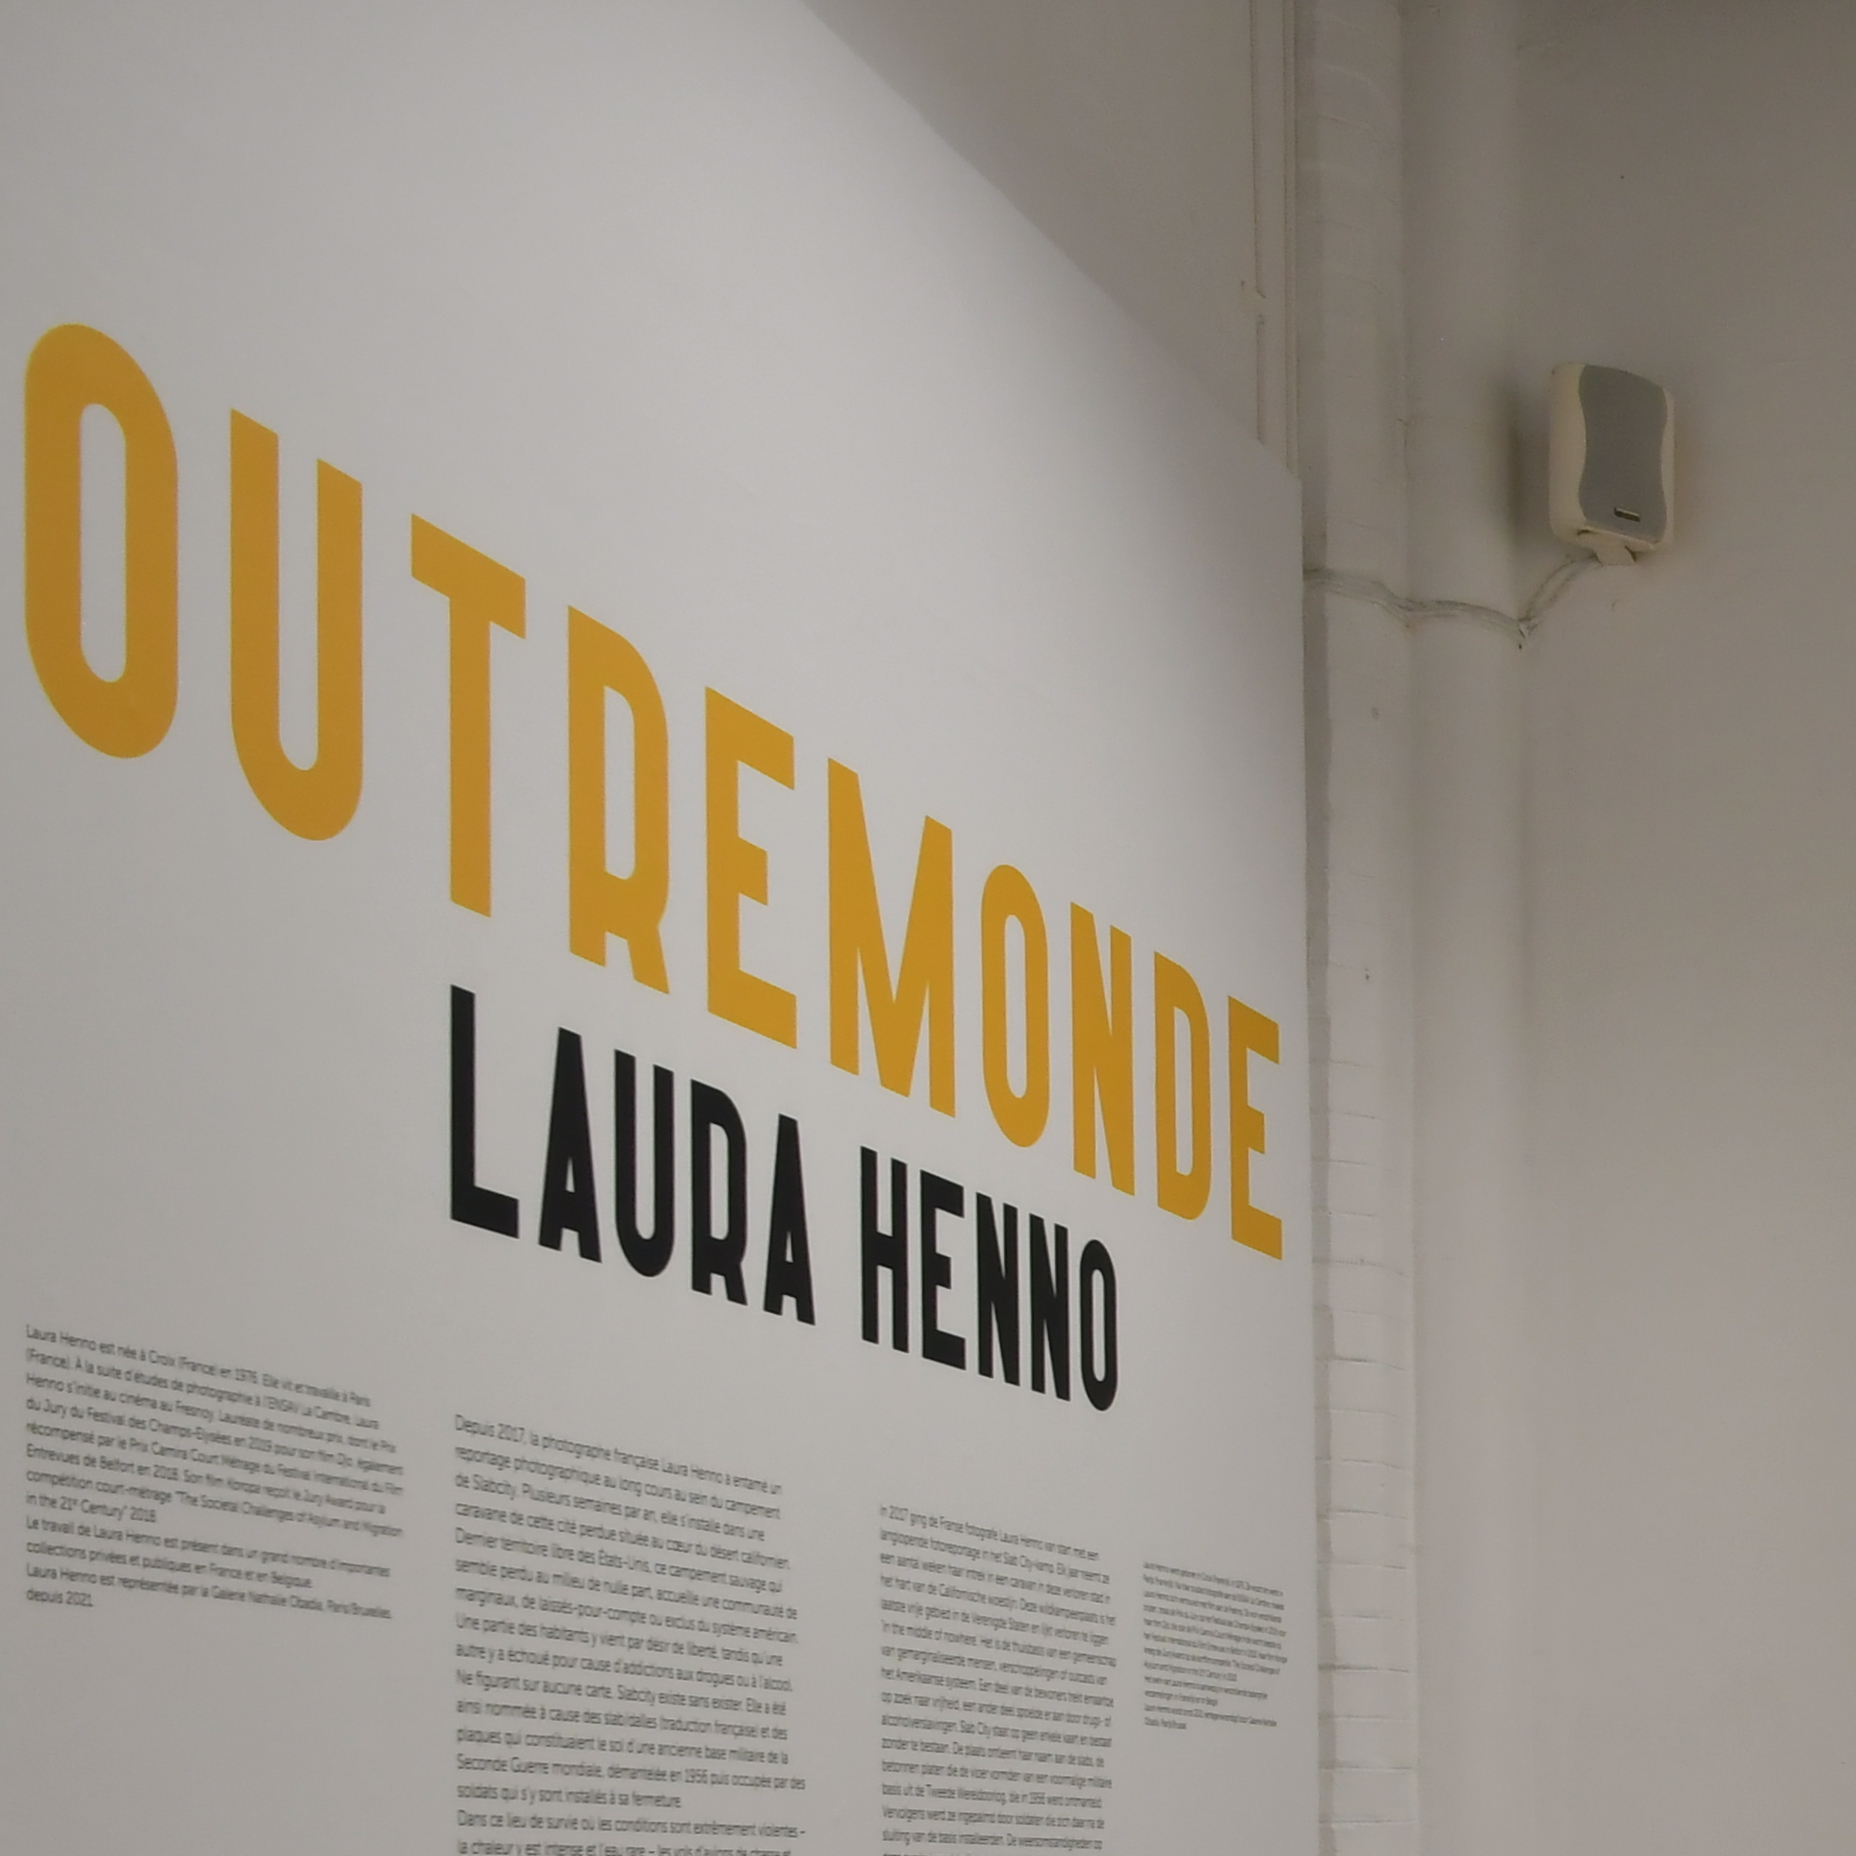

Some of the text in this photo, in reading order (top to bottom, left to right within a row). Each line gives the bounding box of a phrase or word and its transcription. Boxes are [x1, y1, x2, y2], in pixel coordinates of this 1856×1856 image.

[24, 324, 1282, 1259] OUTREMONDE
[451, 986, 1116, 1410] LAURA HENNO
[26, 1323, 56, 1342] Laura
[59, 1330, 96, 1351] Henno
[98, 1342, 115, 1355] est
[117, 1344, 136, 1359] née
[139, 1347, 146, 1361] à
[148, 1349, 175, 1367] Croix
[84, 1359, 94, 1373] la
[96, 1364, 121, 1379] suite
[124, 1367, 168, 1388] d'études
[25, 1371, 64, 1391] Henno
[66, 1380, 100, 1398] s'initie
[103, 1389, 116, 1401] au
[118, 1390, 157, 1409] cinéma
[159, 1400, 172, 1412] au
[26, 1395, 40, 1411] du
[43, 1398, 66, 1418] Jury
[70, 1403, 83, 1418] du
[87, 1406, 125, 1426] Festival
[128, 1414, 146, 1429] des
[26, 1420, 148, 1453] récompensé par le Prix
[25, 1443, 80, 1464] Entrevues
[82, 1452, 96, 1467] de
[99, 1455, 135, 1473] Belfort
[136, 1465, 150, 1476] en
[25, 1490, 36, 1505] in
[38, 1493, 57, 1508] the
[26, 1470, 171, 1504] compétition court-métrage
[26, 1514, 38, 1529] Le
[41, 1517, 74, 1534] travail
[77, 1522, 90, 1536] de
[93, 1524, 123, 1541] Laura
[125, 1528, 161, 1546] Henno
[26, 1540, 191, 1573] collections privées et publiques
[26, 1562, 179, 1593] Laura Henno est représentée
[25, 1586, 63, 1604] depuis
